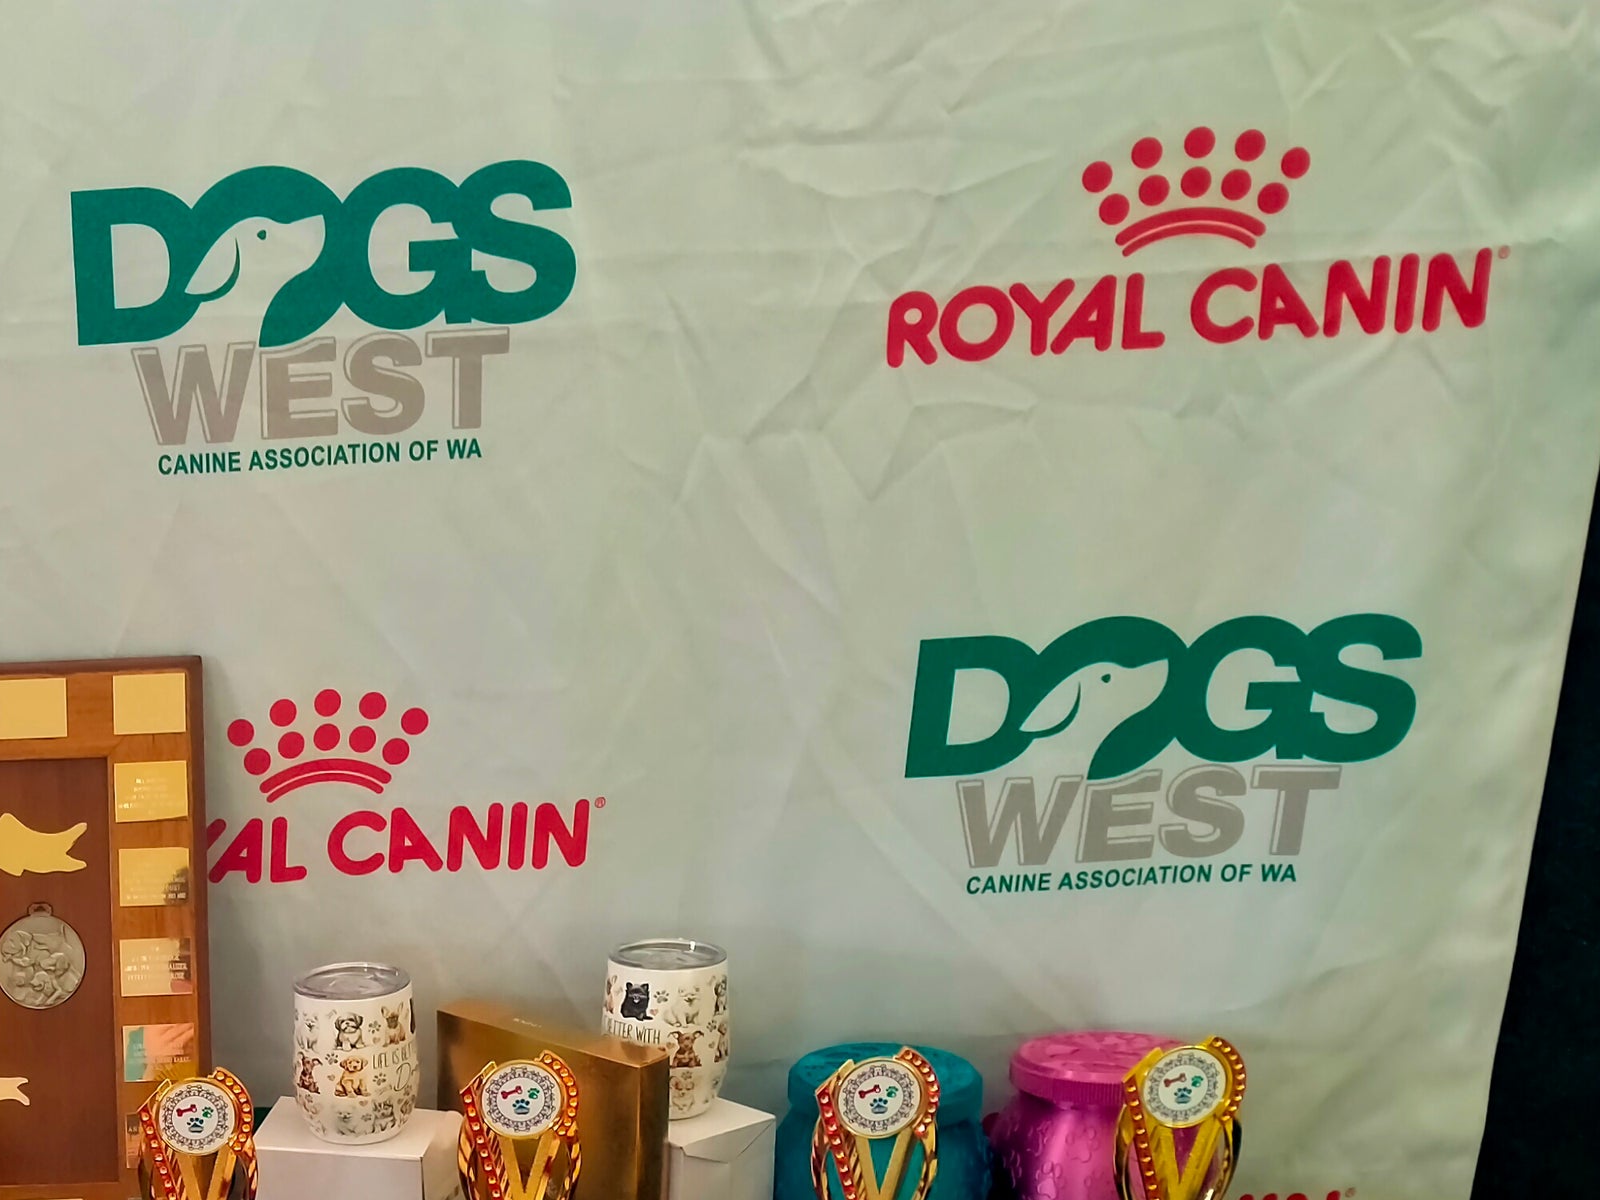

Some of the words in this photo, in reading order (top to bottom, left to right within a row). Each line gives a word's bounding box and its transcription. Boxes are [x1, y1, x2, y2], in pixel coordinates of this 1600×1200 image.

[70, 159, 577, 347] DOGS
[886, 272, 1165, 368] ROYAL
[132, 327, 510, 446] WEST
[158, 450, 242, 476] CANINE
[248, 441, 400, 471] ASSOCIATION
[409, 440, 440, 461] OF
[446, 438, 483, 459] WA
[904, 612, 1423, 780] DOGS
[956, 764, 1341, 869] WEST
[965, 872, 1051, 895] CANINE
[1057, 864, 1215, 891] ASSOCIATION
[1220, 864, 1251, 884] OF
[1260, 863, 1297, 883] WA
[635, 1025, 661, 1045] WITH
